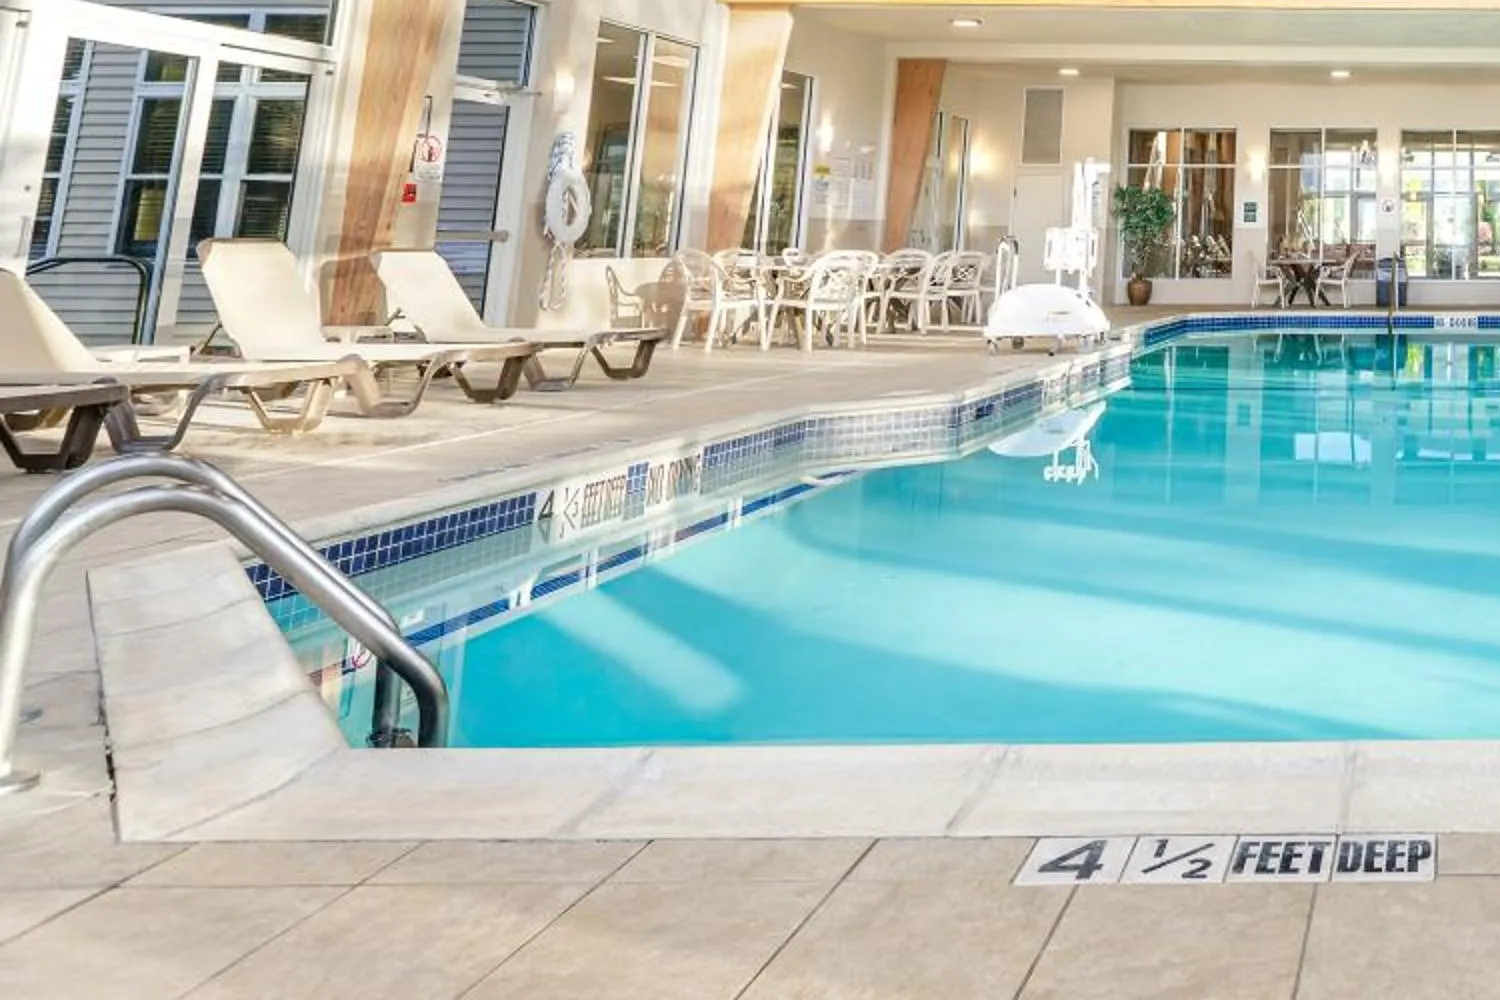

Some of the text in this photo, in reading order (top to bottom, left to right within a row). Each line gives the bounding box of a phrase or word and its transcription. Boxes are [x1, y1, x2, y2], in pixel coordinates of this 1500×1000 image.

[1037, 839, 1108, 880] 4
[1231, 841, 1331, 874] FEET
[1336, 839, 1432, 873] DEEP
